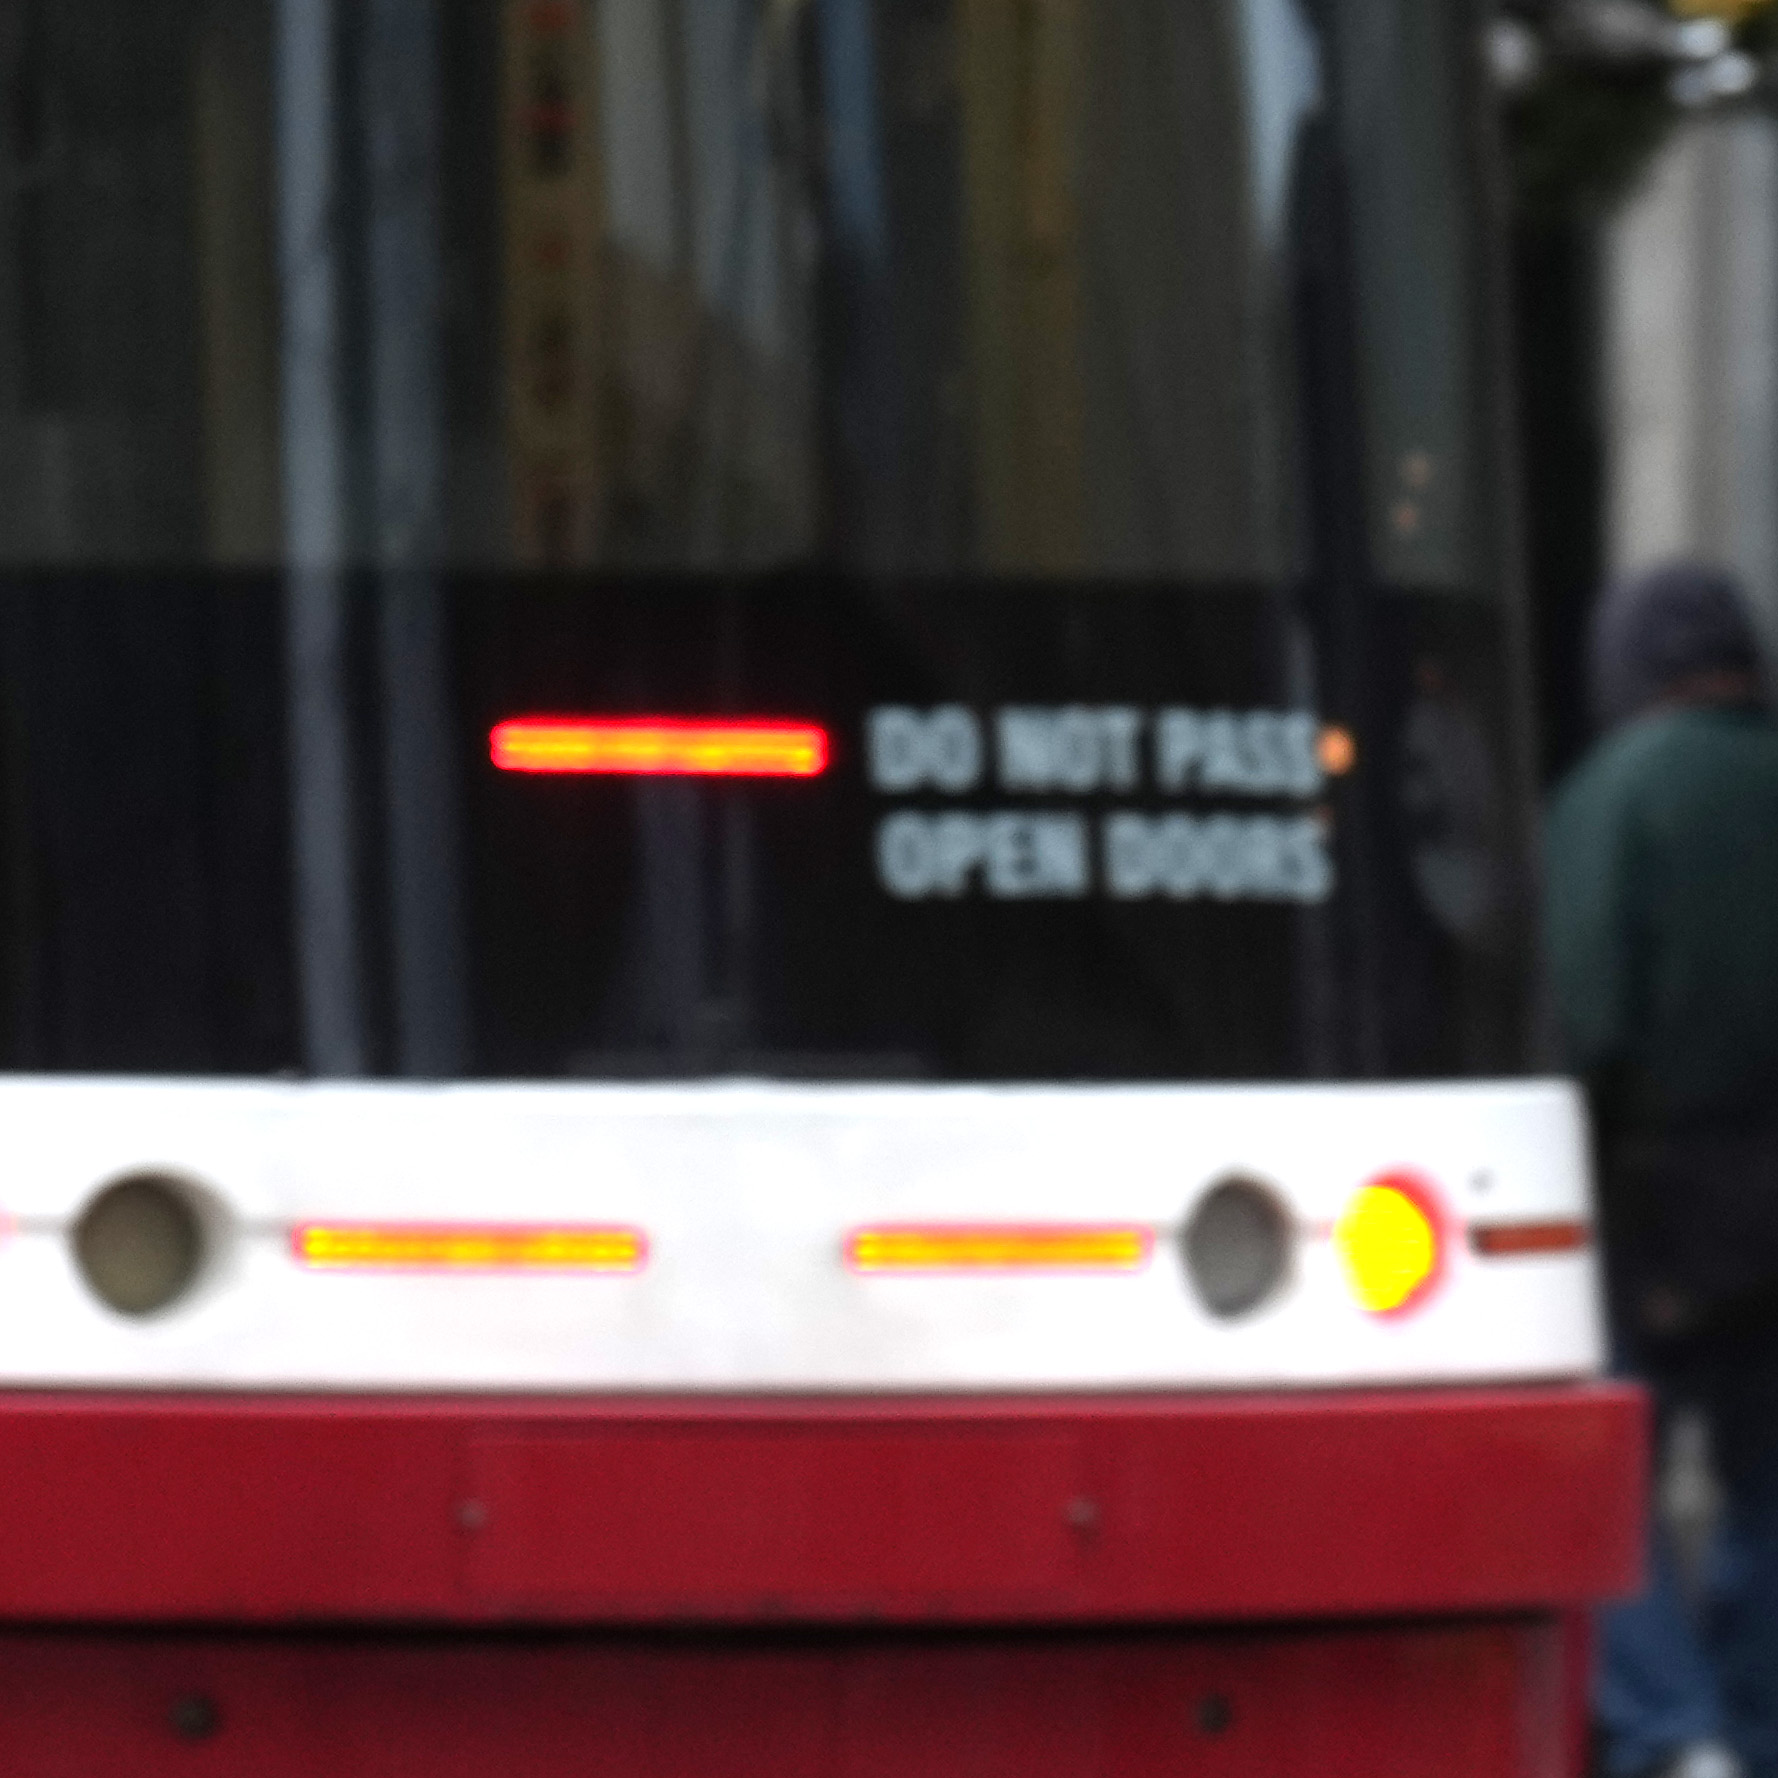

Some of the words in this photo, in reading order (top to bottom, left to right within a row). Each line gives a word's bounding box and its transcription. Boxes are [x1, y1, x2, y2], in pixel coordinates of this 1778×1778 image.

[866, 704, 980, 793] DO
[999, 704, 1138, 794] NOT
[1156, 706, 1322, 795] PASS
[877, 810, 1088, 898] OPEN
[1106, 812, 1332, 905] DOORS
